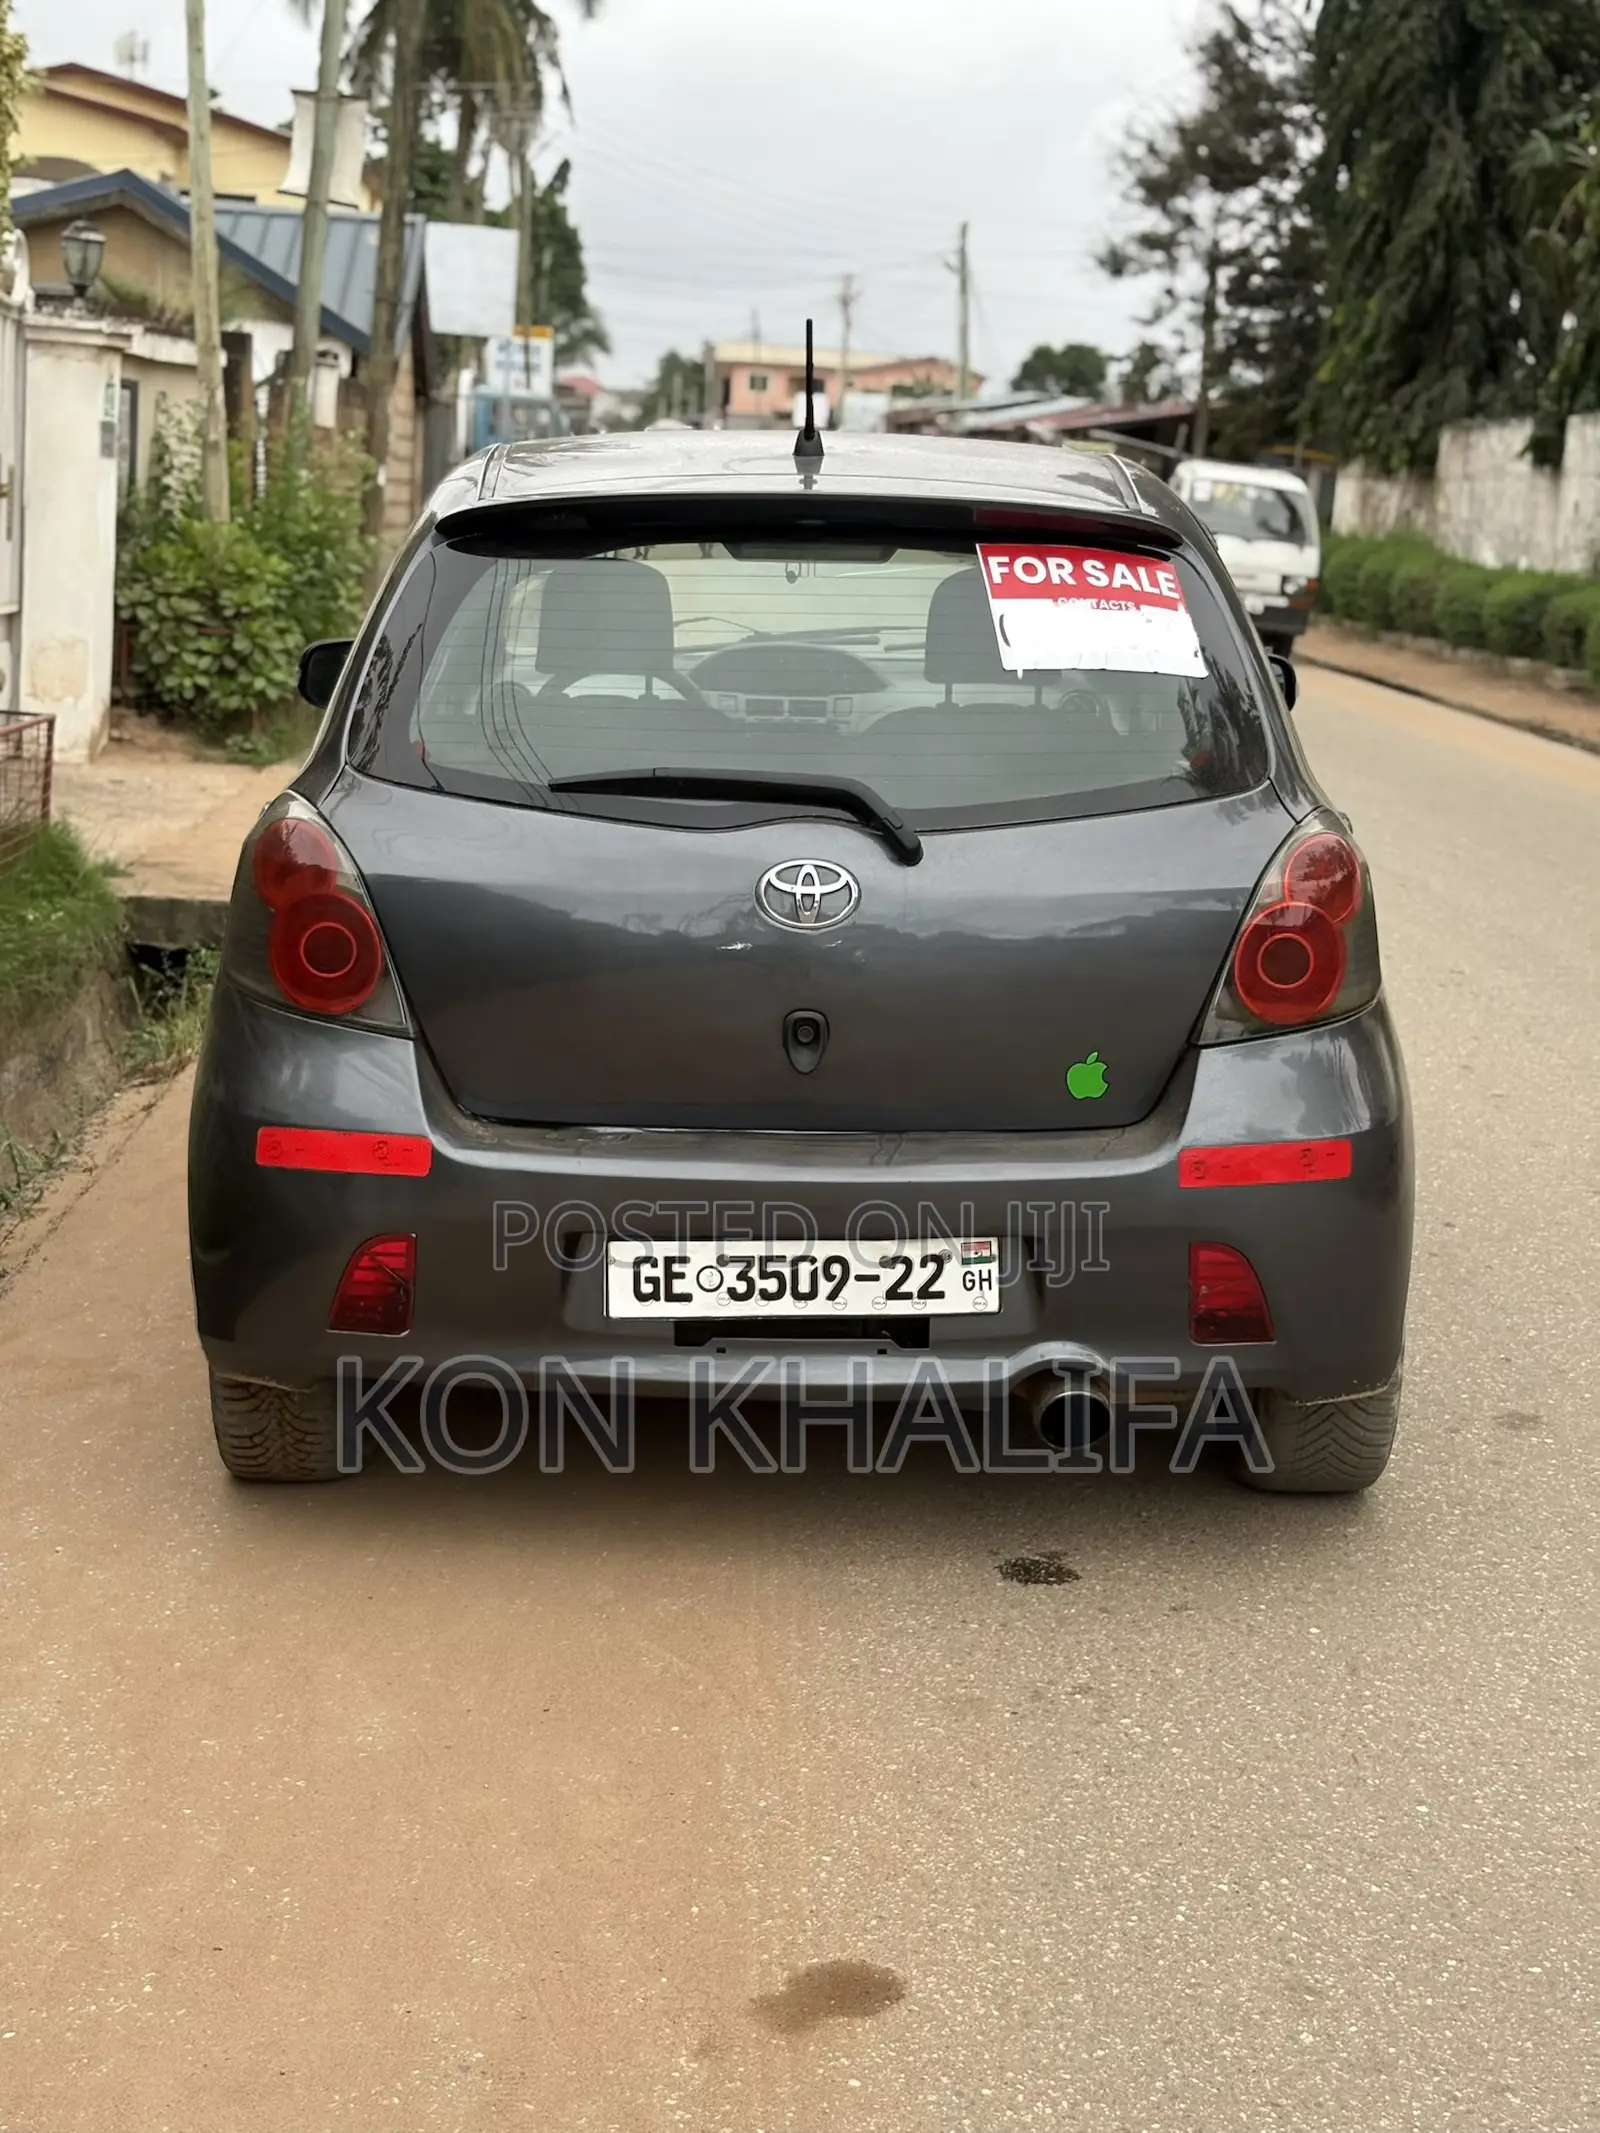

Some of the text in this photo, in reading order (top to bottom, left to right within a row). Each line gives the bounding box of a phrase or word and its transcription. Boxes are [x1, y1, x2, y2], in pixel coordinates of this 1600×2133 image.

[988, 556, 1179, 598] FOR SALE
[632, 1254, 946, 1302] GE 3509-22
[962, 1270, 993, 1292] GH
